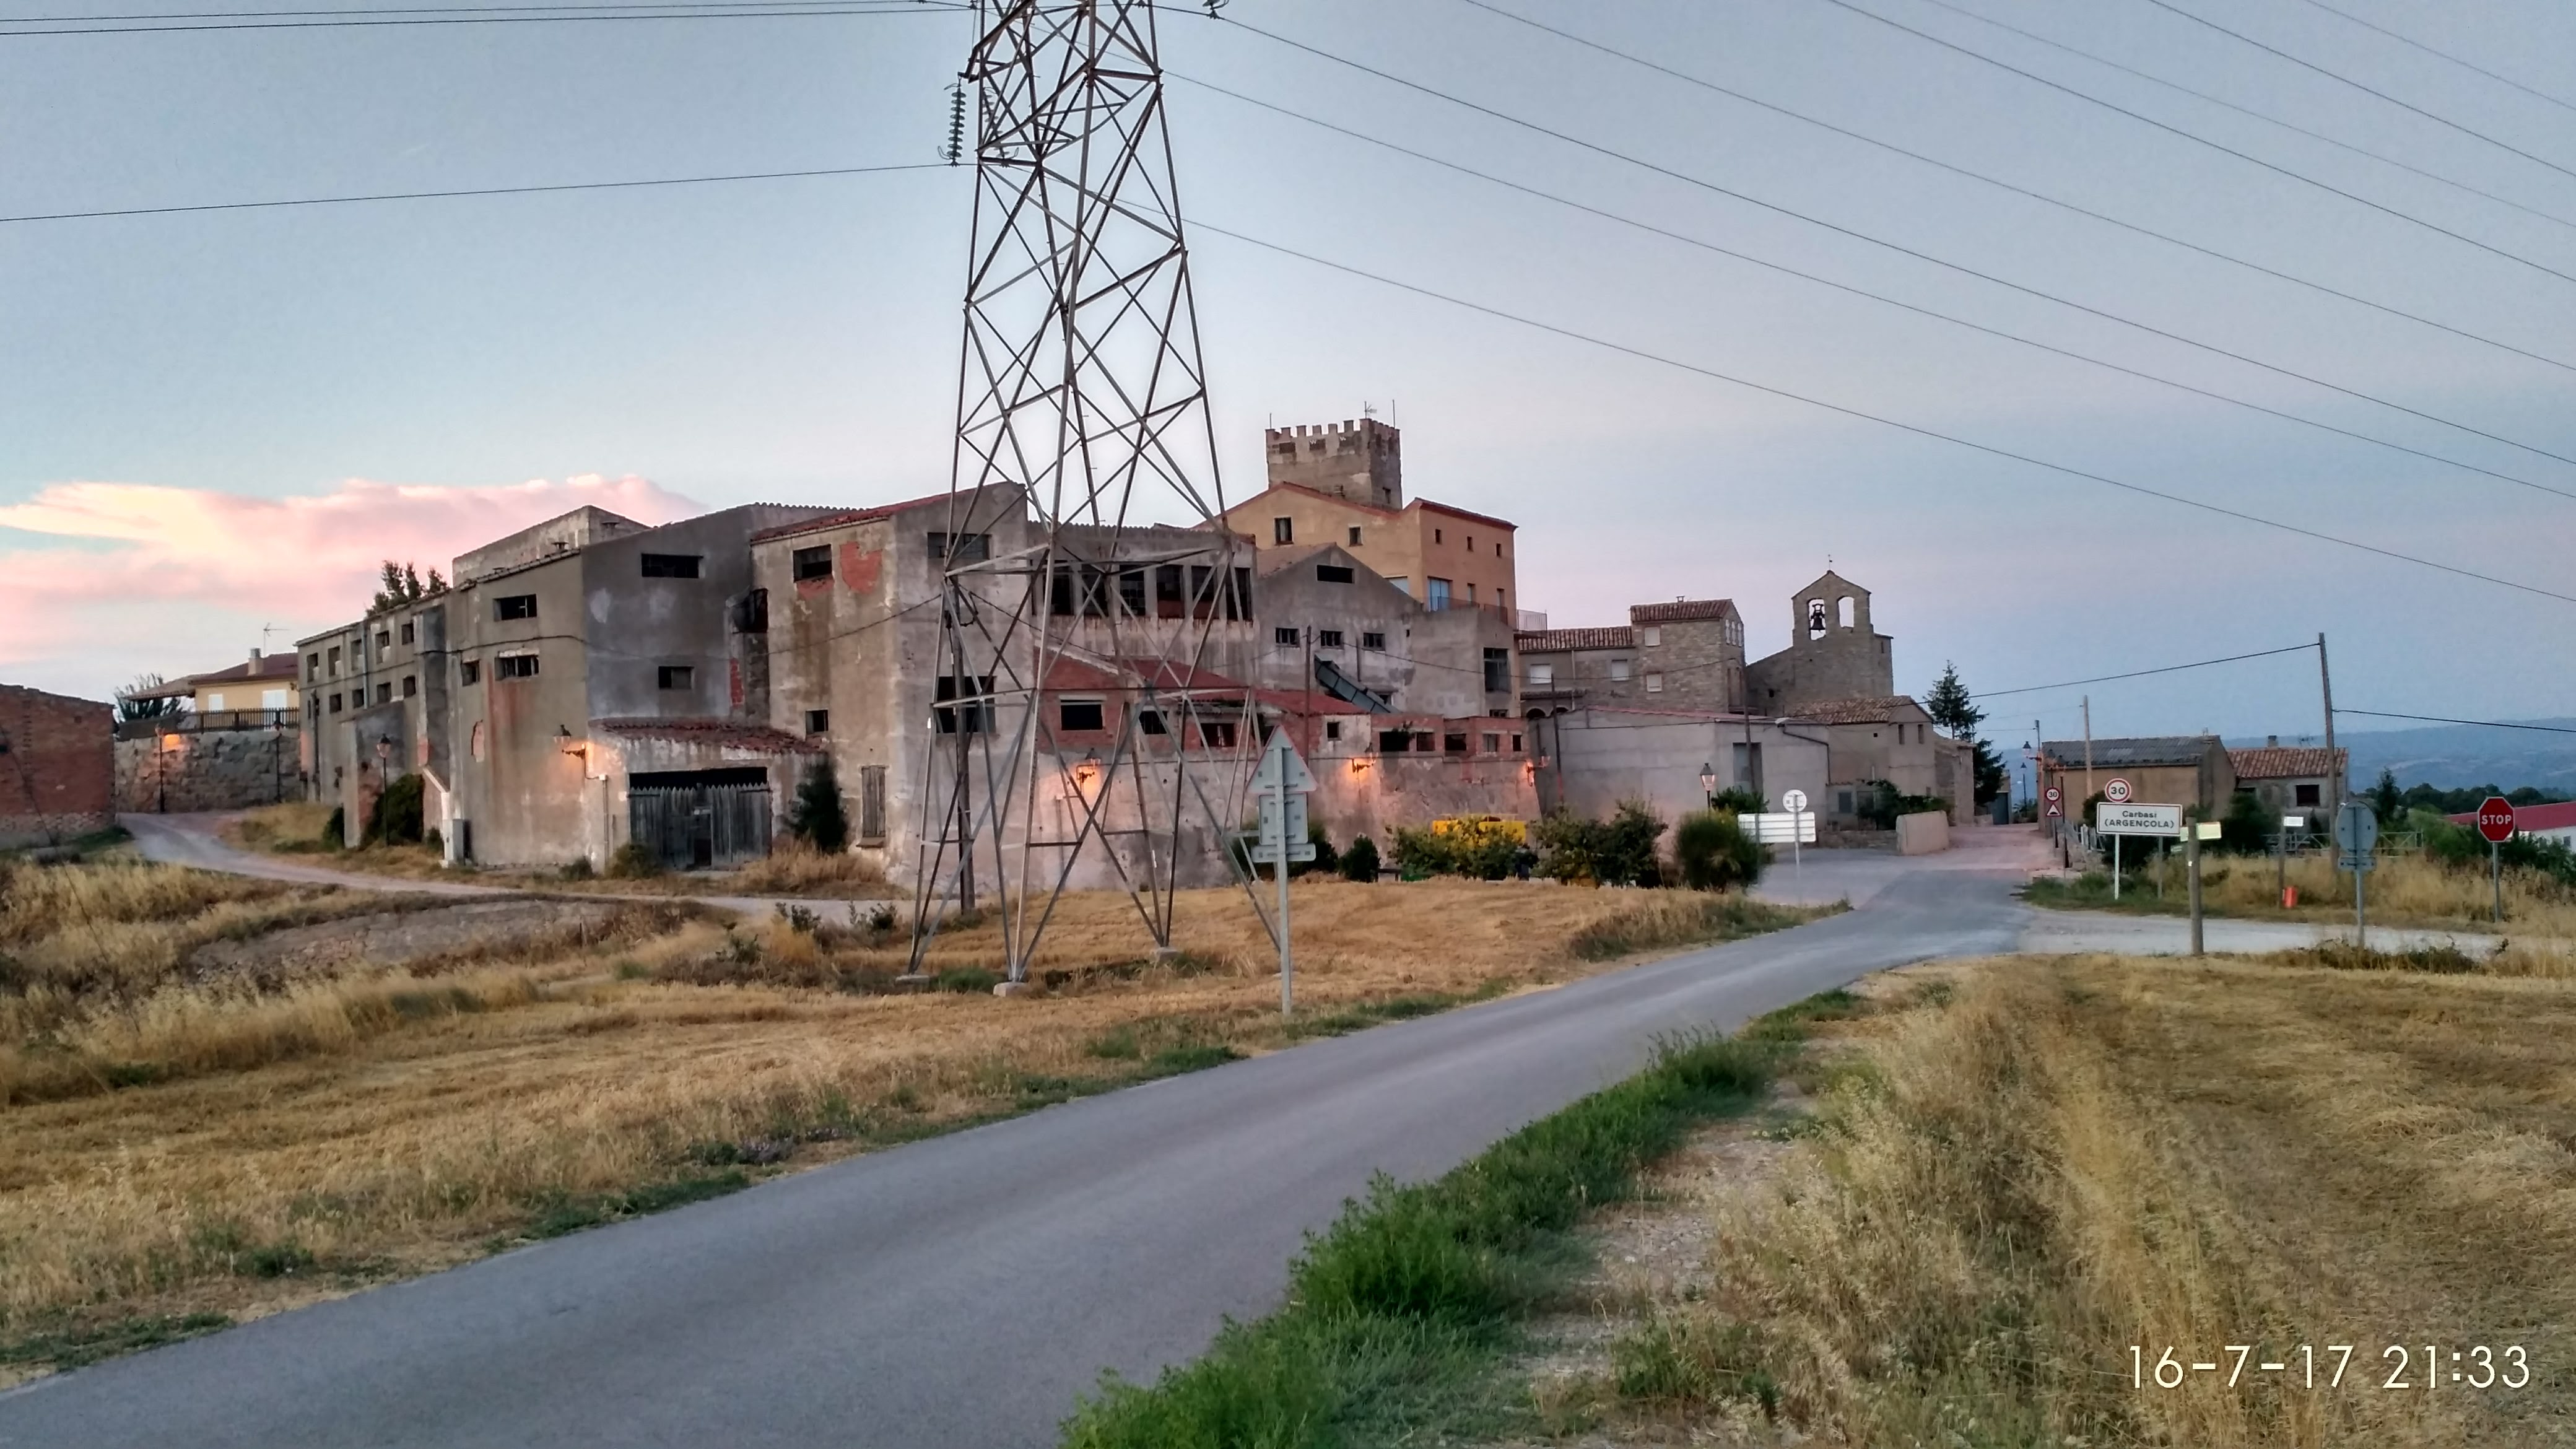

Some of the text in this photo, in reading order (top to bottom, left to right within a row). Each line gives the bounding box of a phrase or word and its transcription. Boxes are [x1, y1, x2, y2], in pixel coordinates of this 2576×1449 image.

[2110, 786, 2126, 795] 30
[2104, 818, 2175, 829] (ARGENÇOLA)
[2481, 814, 2512, 825] STOP
